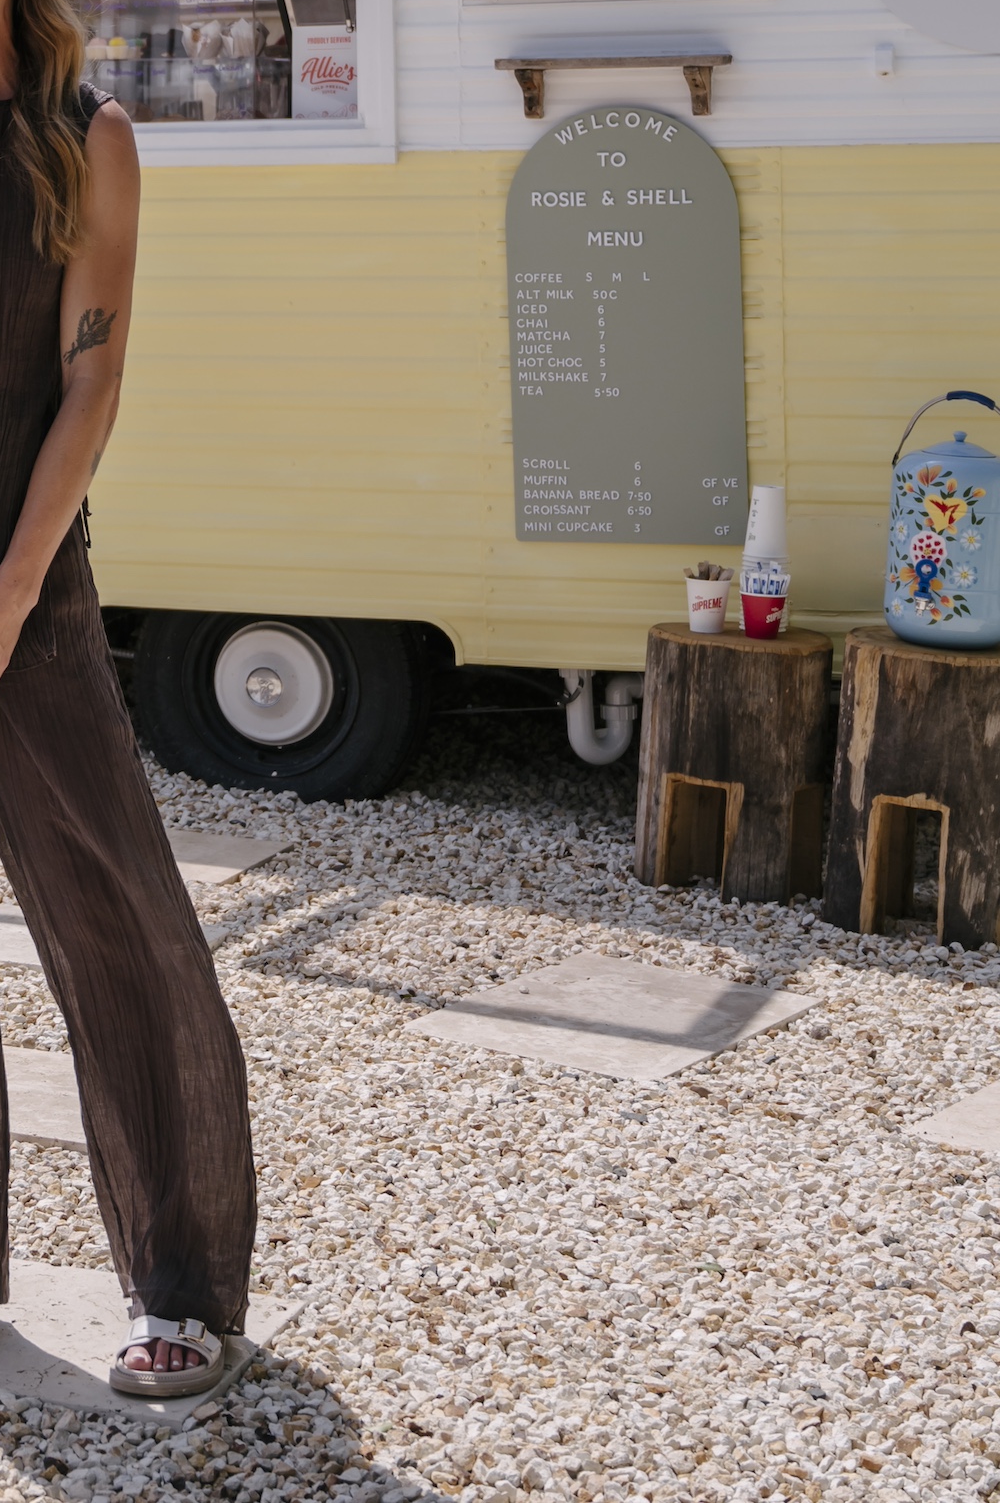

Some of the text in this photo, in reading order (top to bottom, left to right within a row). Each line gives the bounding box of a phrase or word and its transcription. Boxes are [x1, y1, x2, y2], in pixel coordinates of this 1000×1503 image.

[330, 36, 352, 44] SERVING
[301, 56, 358, 85] Allie's
[553, 110, 681, 146] WELCOME
[596, 151, 626, 168] TO
[531, 188, 693, 208] ROSIE & SHELL
[587, 231, 643, 247] MENU
[514, 271, 651, 283] COFFEE S M L
[516, 289, 618, 300] ALT MILK 50C
[517, 303, 605, 315] ICED 6
[516, 317, 606, 329] CHAI 6
[516, 330, 606, 342] MATCHA 7
[517, 343, 606, 355] JUICE 5
[517, 357, 606, 368] HOT CHOC 5
[518, 371, 607, 383] MILKSHAKE 7
[519, 385, 544, 396] TEA
[522, 457, 642, 471] SCROLL 6
[523, 474, 739, 489] MUFFIN 6 GF VE
[523, 489, 574, 500] BANANA
[579, 489, 620, 501] BREAD
[712, 495, 729, 506] GF
[523, 504, 592, 516] CROISSANT
[524, 521, 730, 536] MINI CUPCAKE 3 GF
[692, 596, 723, 612] SUPREME
